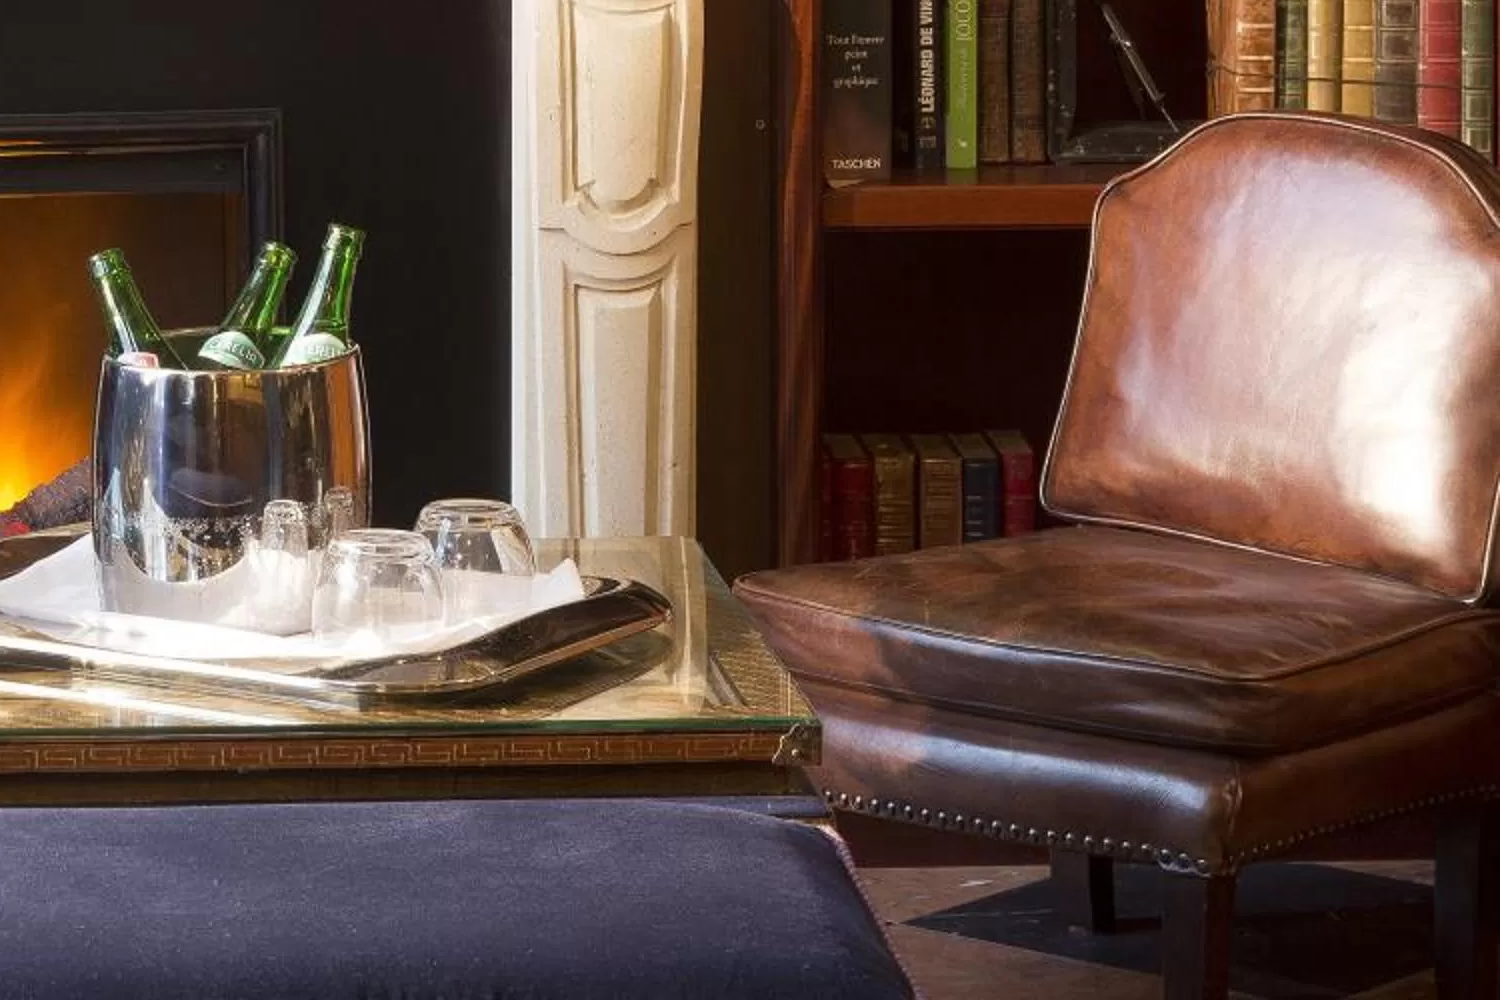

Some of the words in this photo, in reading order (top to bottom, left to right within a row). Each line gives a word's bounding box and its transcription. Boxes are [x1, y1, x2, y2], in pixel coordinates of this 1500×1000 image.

[919, 27, 933, 46] DE
[918, 49, 935, 113] LÉONARD
[830, 157, 881, 169] TASCHEN
